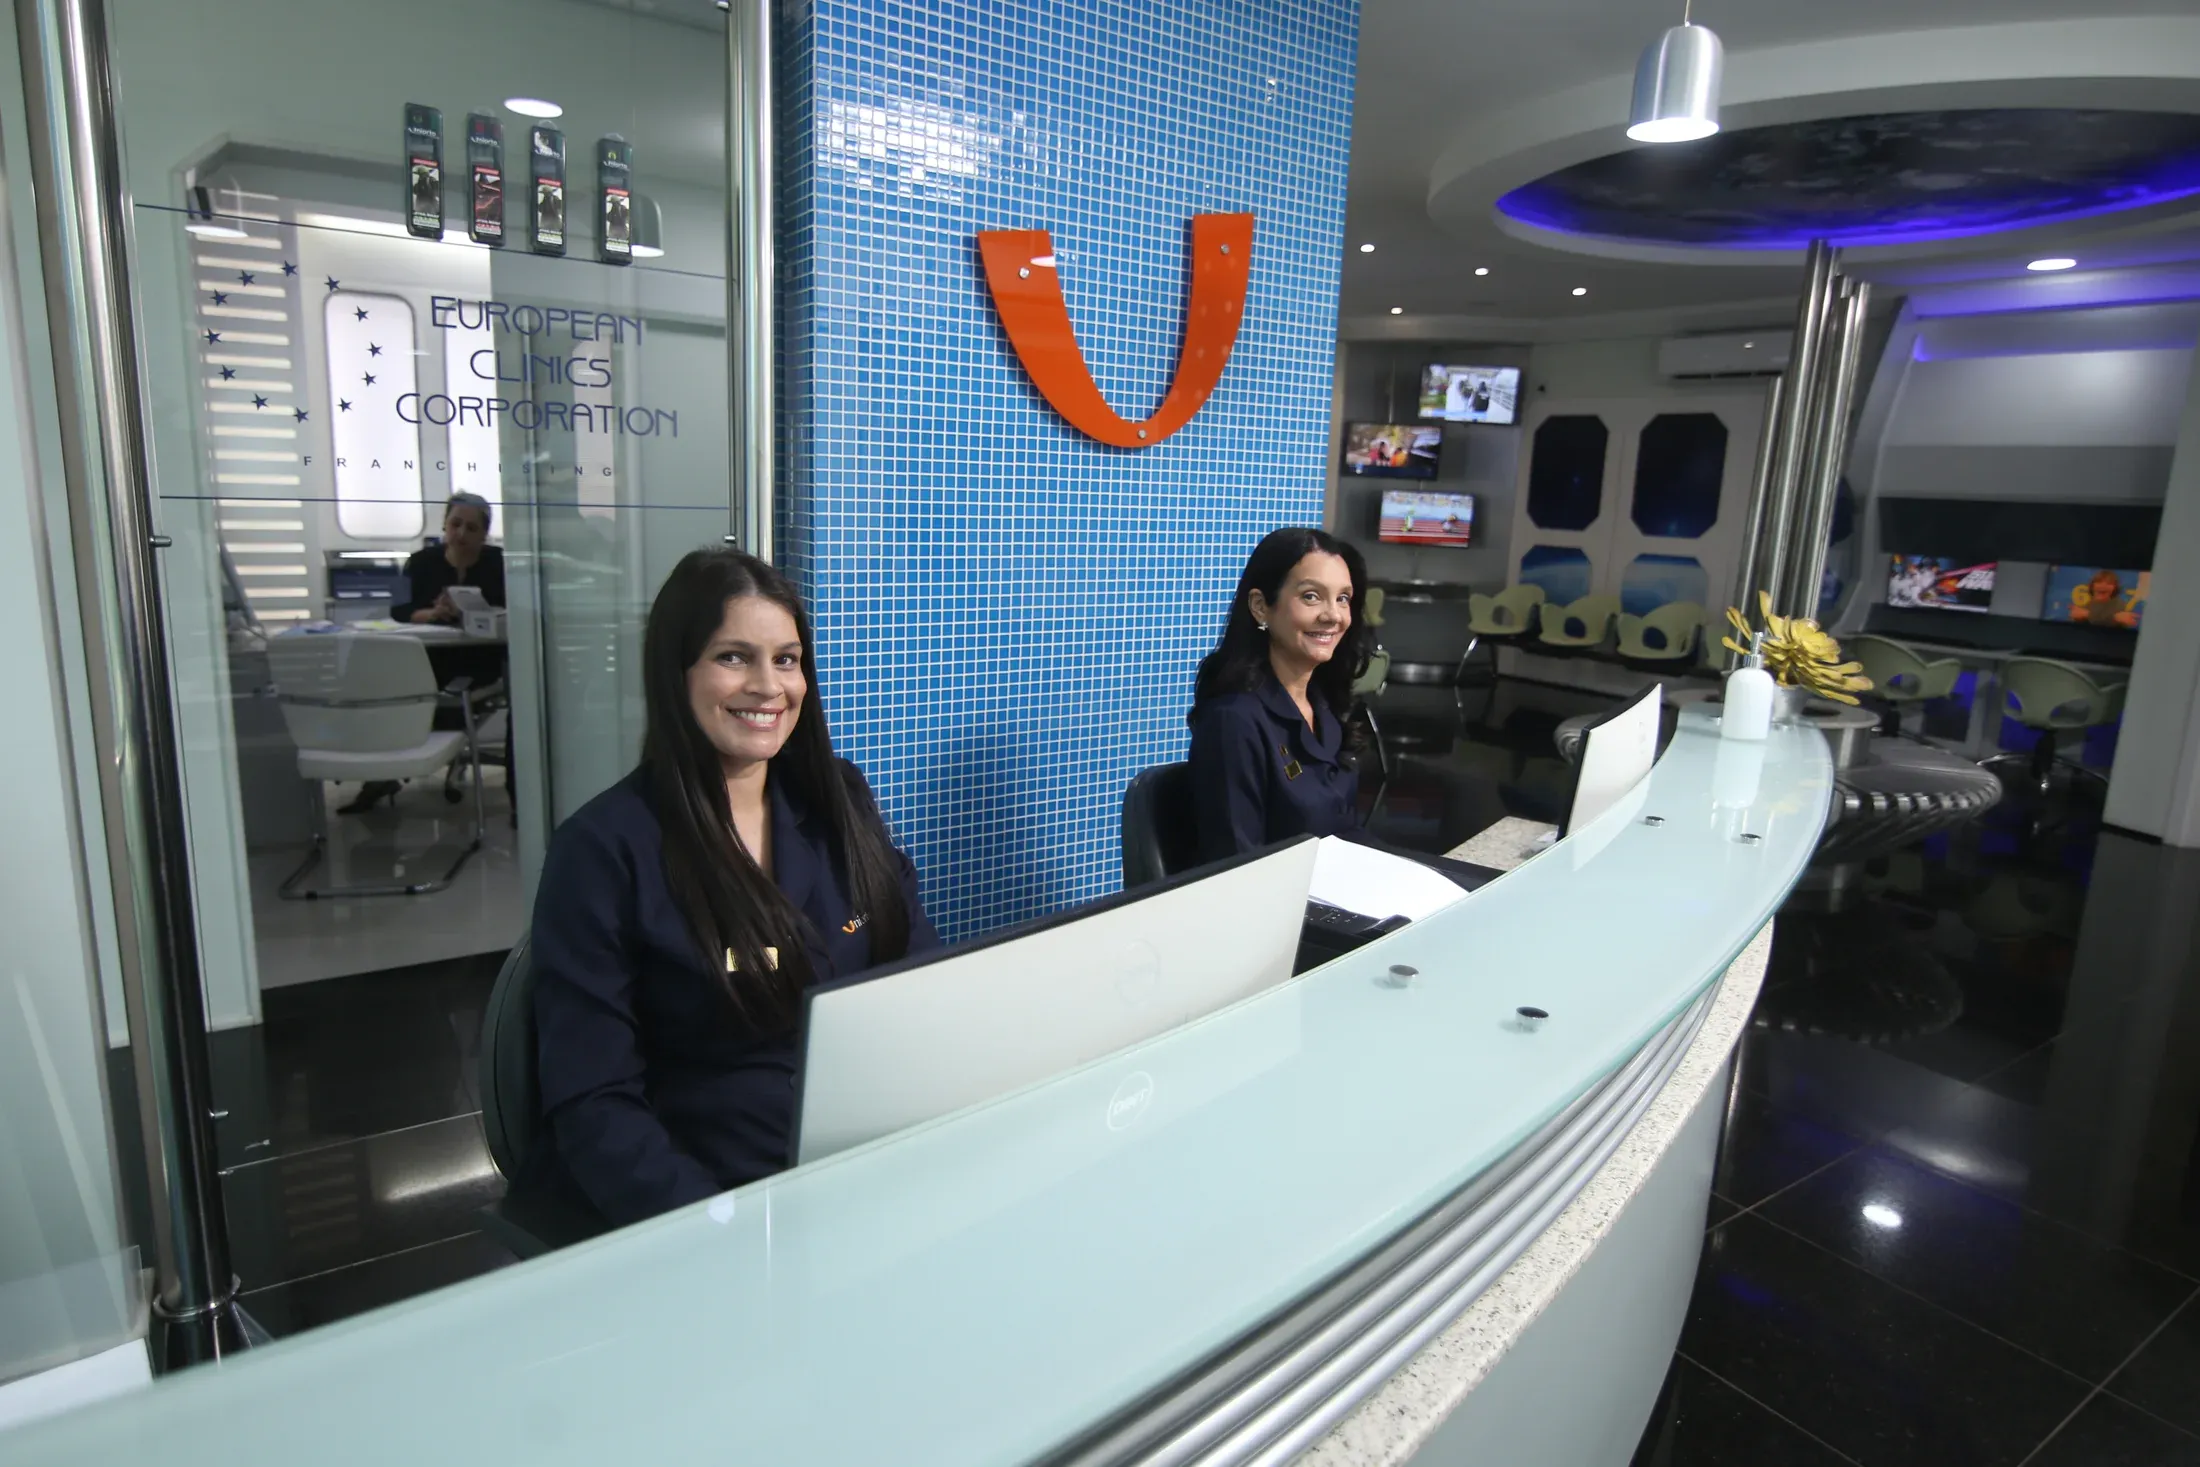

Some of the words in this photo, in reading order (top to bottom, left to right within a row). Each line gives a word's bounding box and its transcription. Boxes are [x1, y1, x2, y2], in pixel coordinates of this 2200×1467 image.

[431, 295, 642, 346] EUROPEAN
[470, 349, 612, 388] CLINICS
[396, 392, 678, 438] CORPORATION
[303, 455, 612, 476] FRANCHISING
